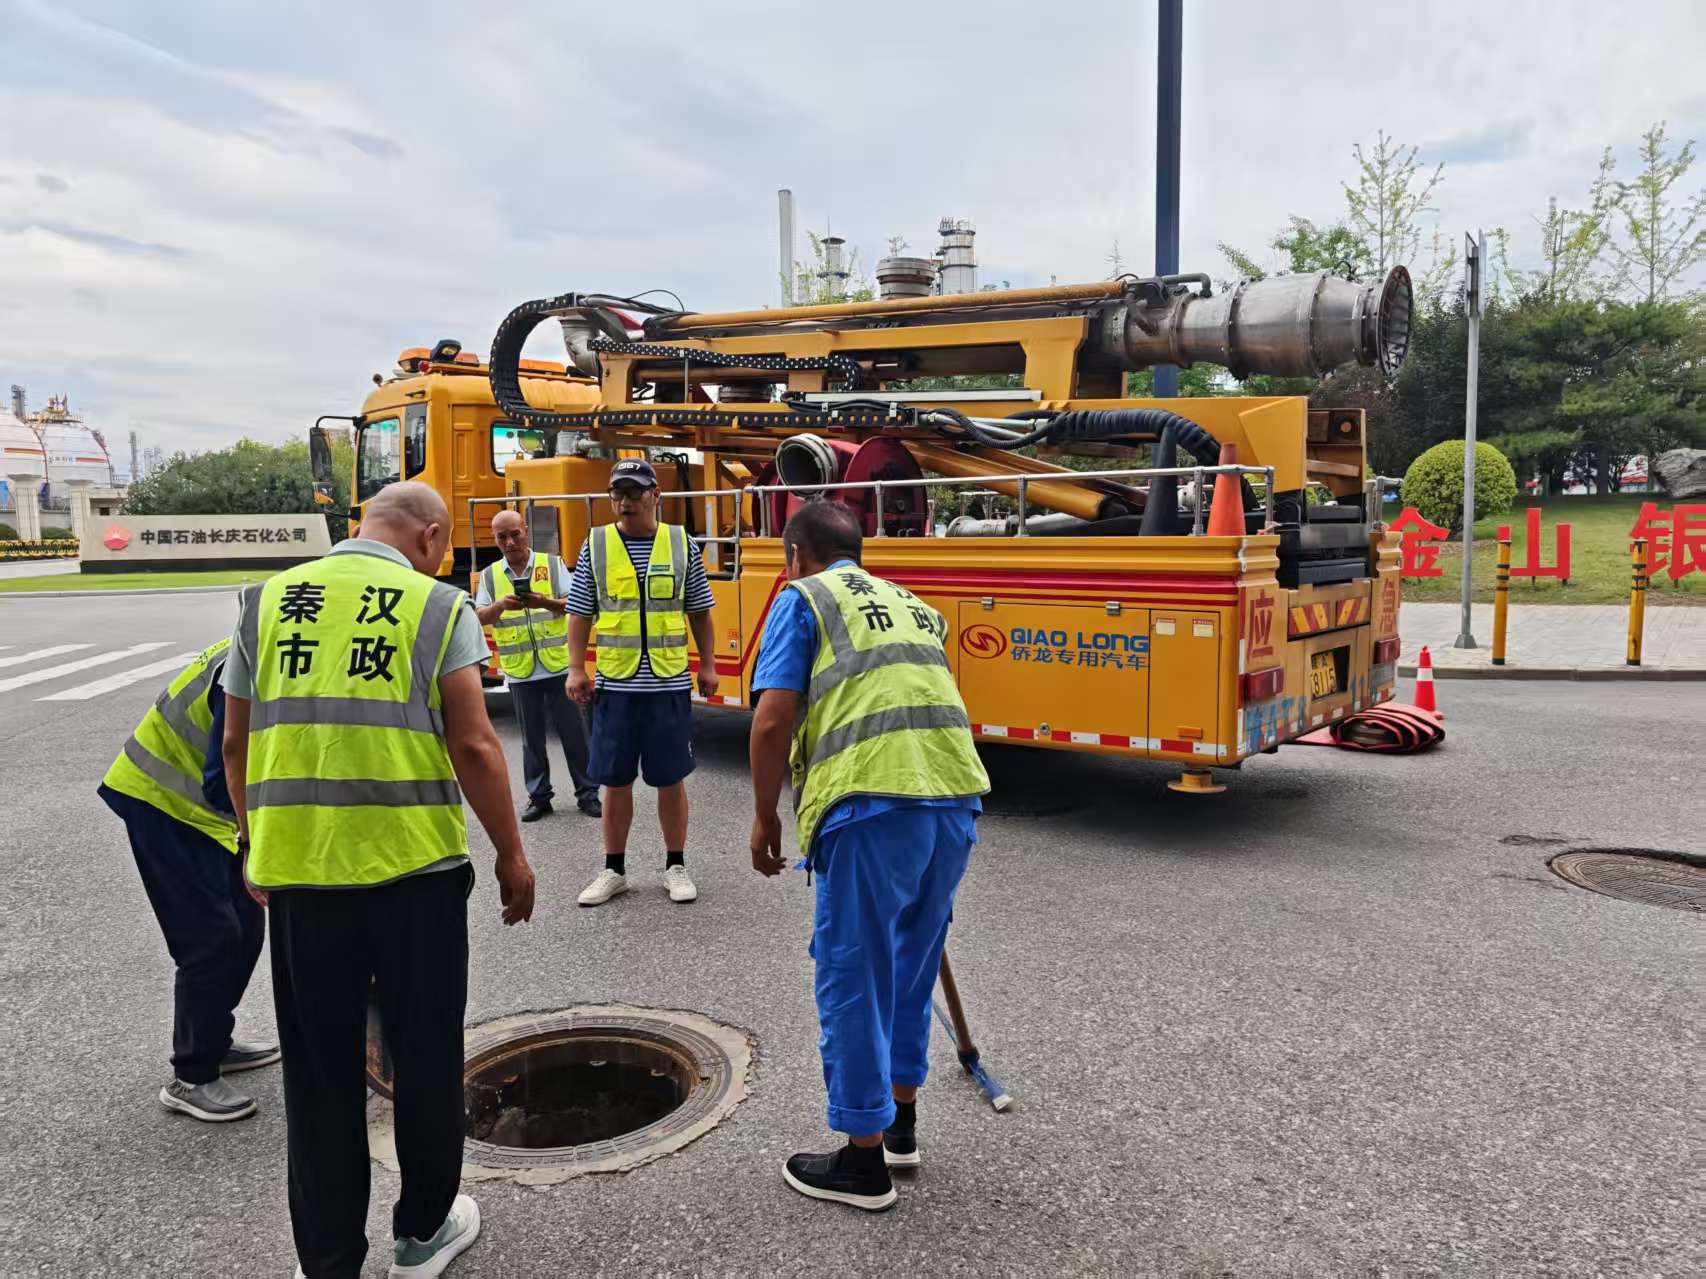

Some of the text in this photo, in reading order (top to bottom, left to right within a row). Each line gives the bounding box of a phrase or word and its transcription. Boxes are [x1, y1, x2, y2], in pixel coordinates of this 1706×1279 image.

[140, 527, 308, 545] 中国石油长庆石化公司
[278, 581, 405, 627] 秦汉
[1010, 627, 1149, 653] QIAO LONG
[1246, 589, 1275, 662] 应
[276, 631, 398, 682] 市政
[1010, 645, 1149, 671] 侨龙专用汽车
[1310, 667, 1337, 696] 8115
